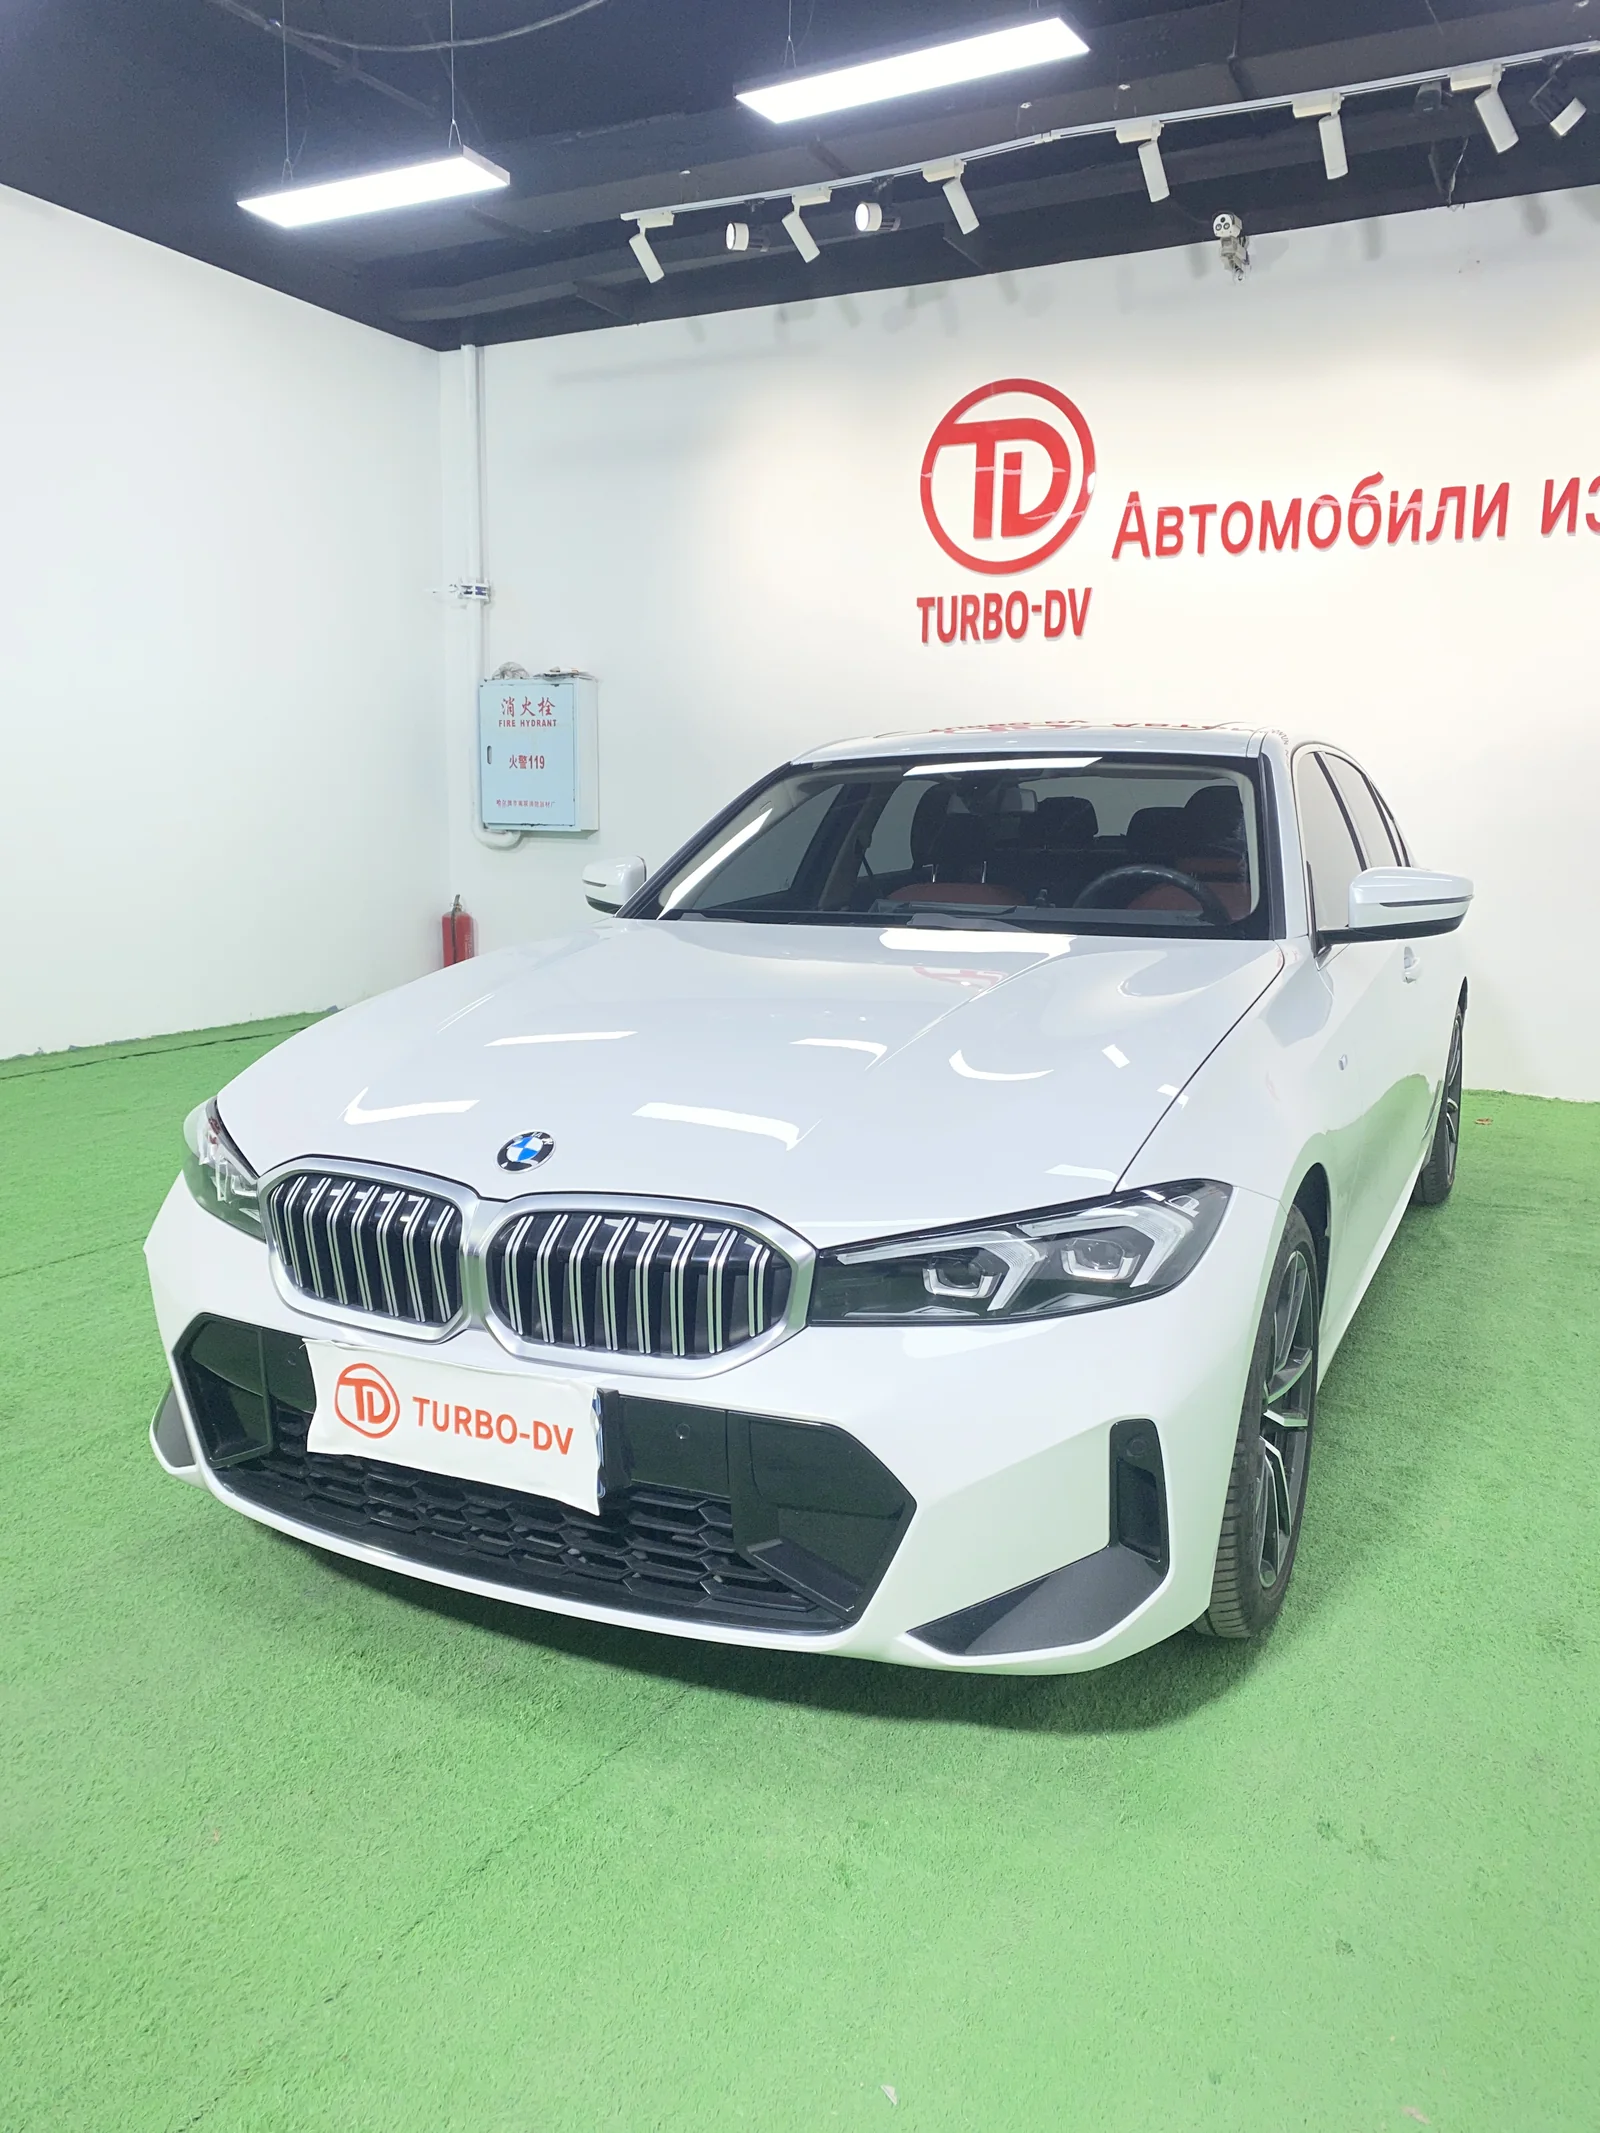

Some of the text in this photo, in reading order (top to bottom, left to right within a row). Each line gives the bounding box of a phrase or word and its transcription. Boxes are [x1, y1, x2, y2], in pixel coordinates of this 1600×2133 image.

[1112, 472, 1509, 560] Автомобили
[916, 587, 1092, 644] TURBO-DV
[498, 719, 557, 728] FIRE HYDRANT
[501, 696, 555, 717] 消火栓
[508, 754, 545, 769] 火警119
[412, 1396, 574, 1455] TURBO-DV
